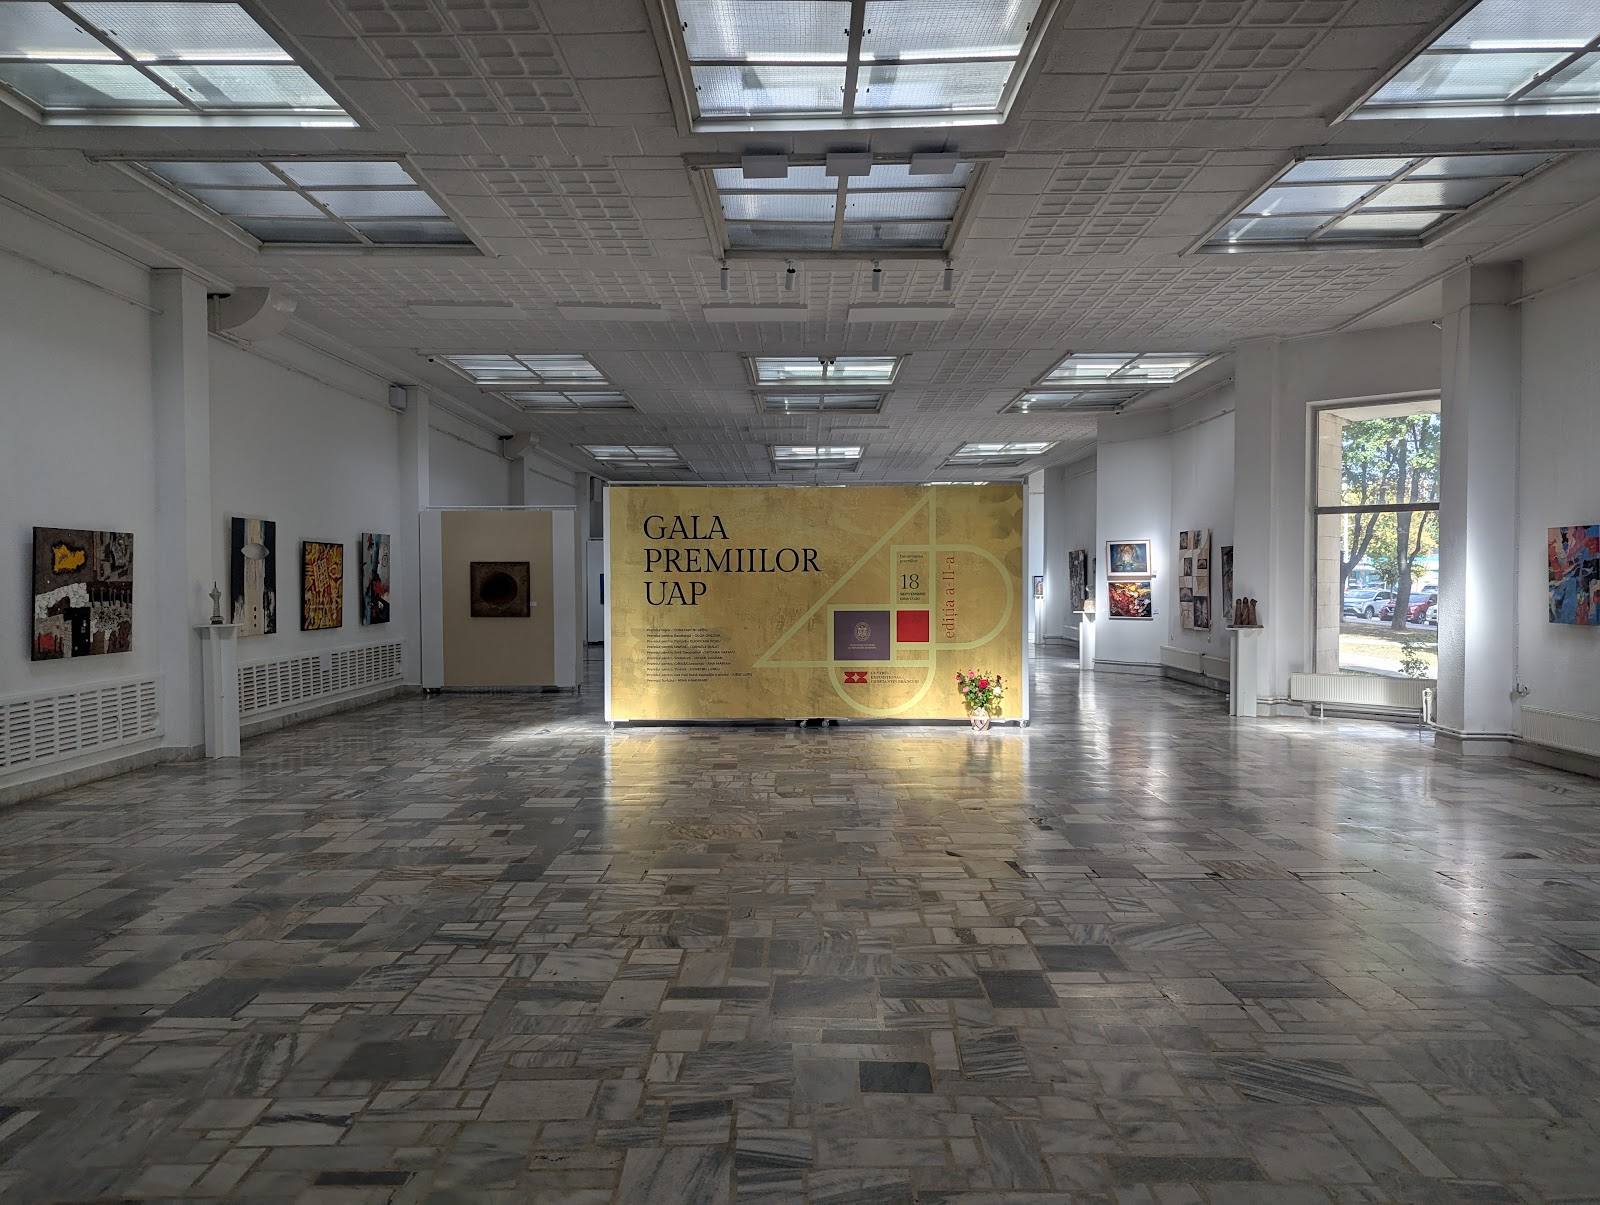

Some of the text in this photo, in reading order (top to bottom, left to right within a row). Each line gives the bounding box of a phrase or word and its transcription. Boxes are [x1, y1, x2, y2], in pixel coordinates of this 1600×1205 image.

[643, 515, 730, 540] GALA
[643, 548, 821, 573] PREMIILOR
[643, 581, 707, 606] UAP
[899, 573, 920, 590] 18
